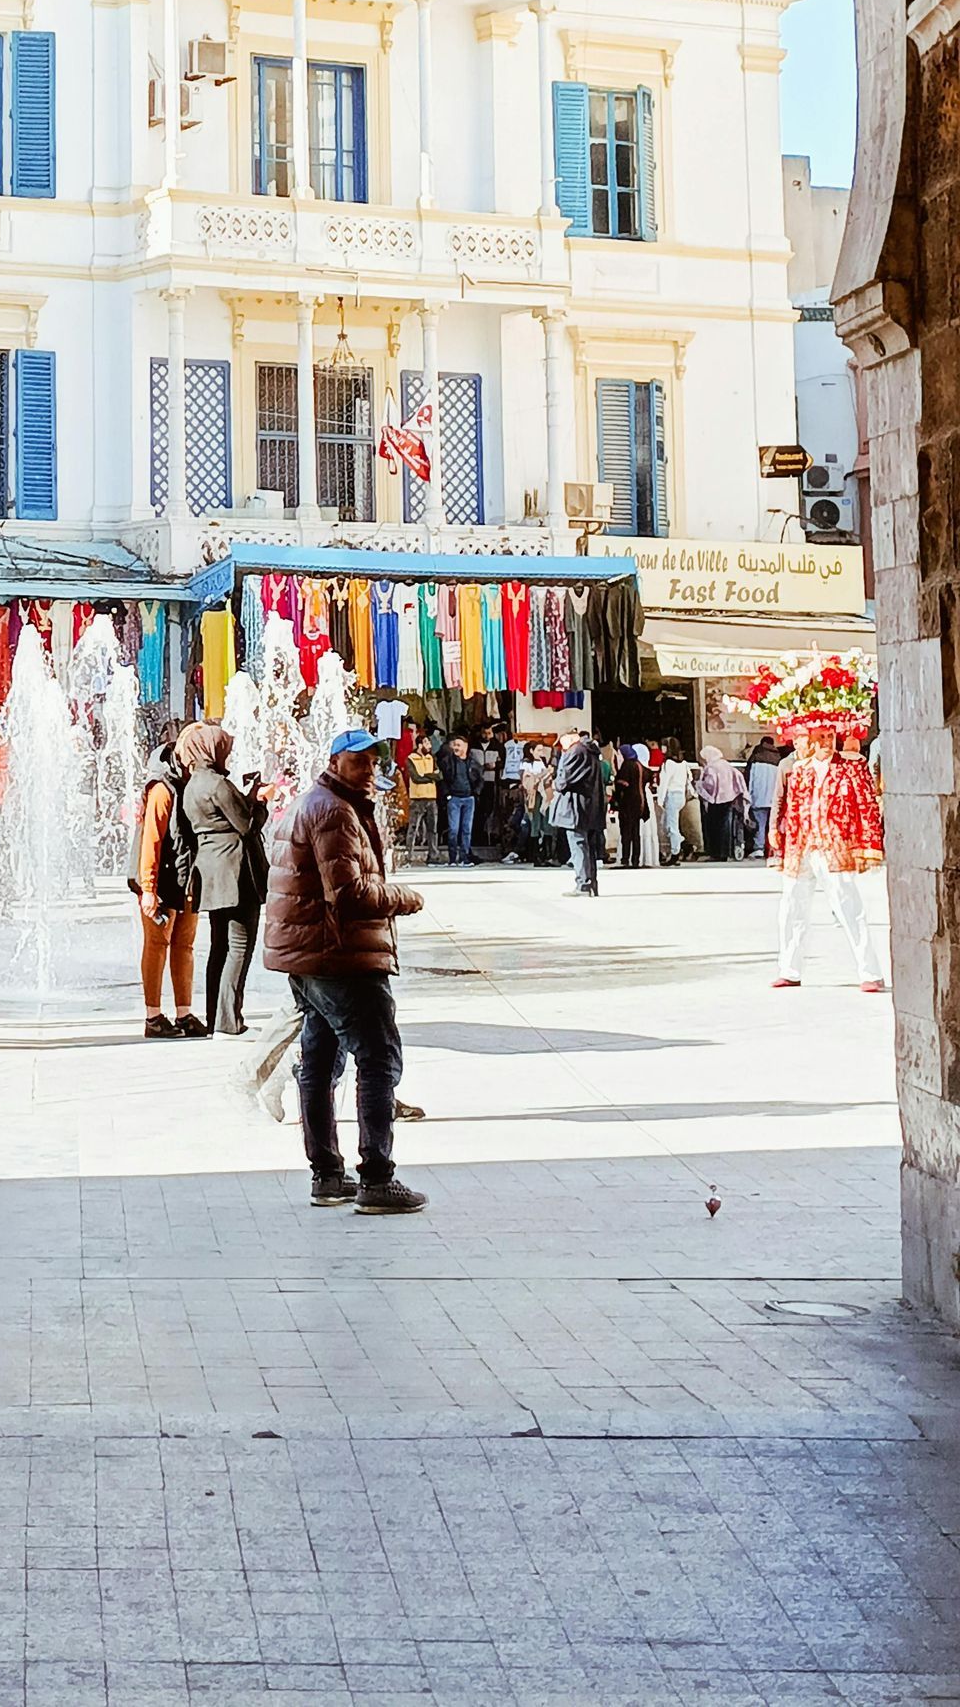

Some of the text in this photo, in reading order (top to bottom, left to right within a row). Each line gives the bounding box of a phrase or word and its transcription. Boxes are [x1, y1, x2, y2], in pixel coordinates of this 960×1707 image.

[662, 547, 677, 571] de
[679, 549, 695, 572] la
[697, 550, 728, 573] Ville
[737, 548, 843, 585] في قلب المدينة
[669, 578, 780, 604] Fast Food
[672, 657, 688, 671] Au
[690, 657, 720, 673] Coeur
[723, 657, 736, 673] de
[738, 660, 752, 673] la
